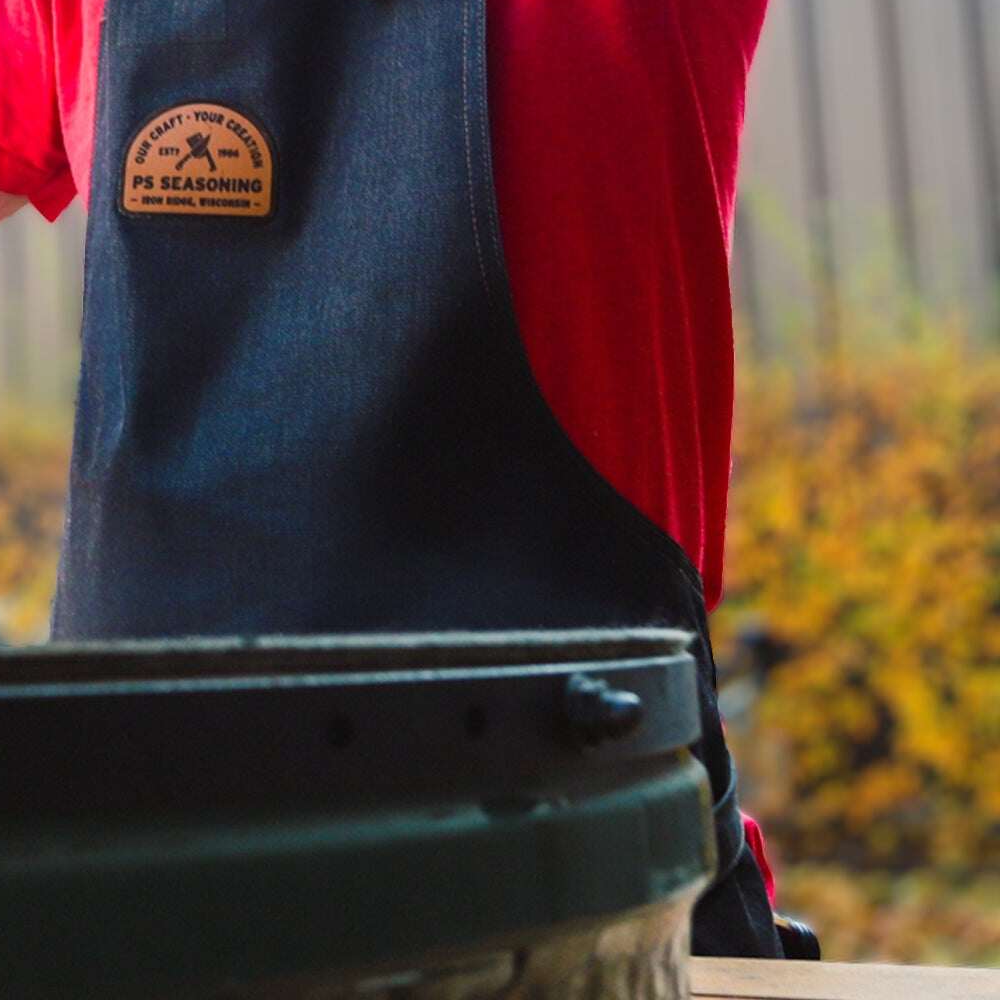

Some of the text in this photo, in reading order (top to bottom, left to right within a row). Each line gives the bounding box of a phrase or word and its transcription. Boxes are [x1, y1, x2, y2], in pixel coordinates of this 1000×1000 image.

[135, 111, 263, 168] OUR CRAFT YOUR CREATION
[132, 175, 263, 193] PS SEASONING
